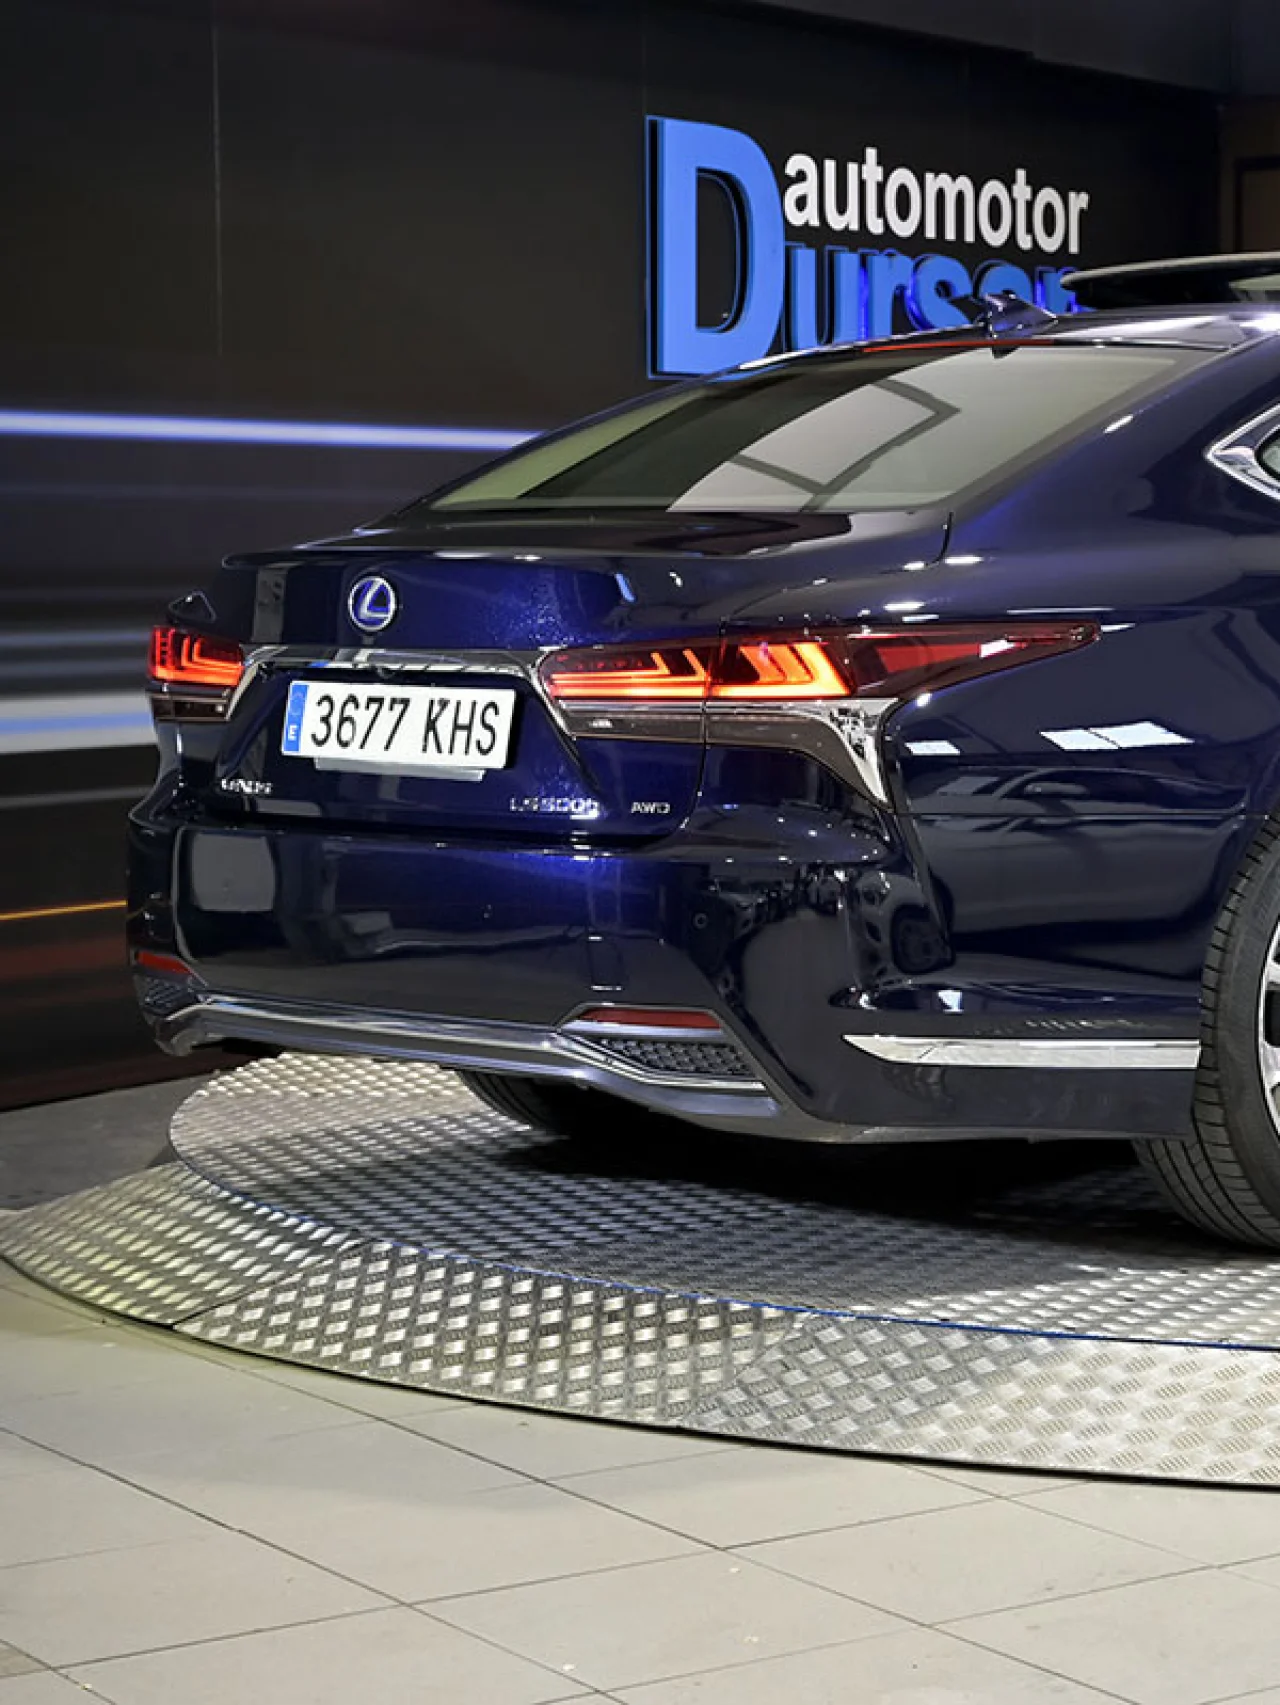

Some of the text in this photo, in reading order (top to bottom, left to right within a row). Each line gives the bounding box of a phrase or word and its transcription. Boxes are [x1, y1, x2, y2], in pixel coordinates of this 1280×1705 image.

[783, 147, 1089, 254] automotor
[287, 724, 298, 741] E
[310, 693, 500, 756] 3677 KHS
[630, 801, 671, 814] AWD
